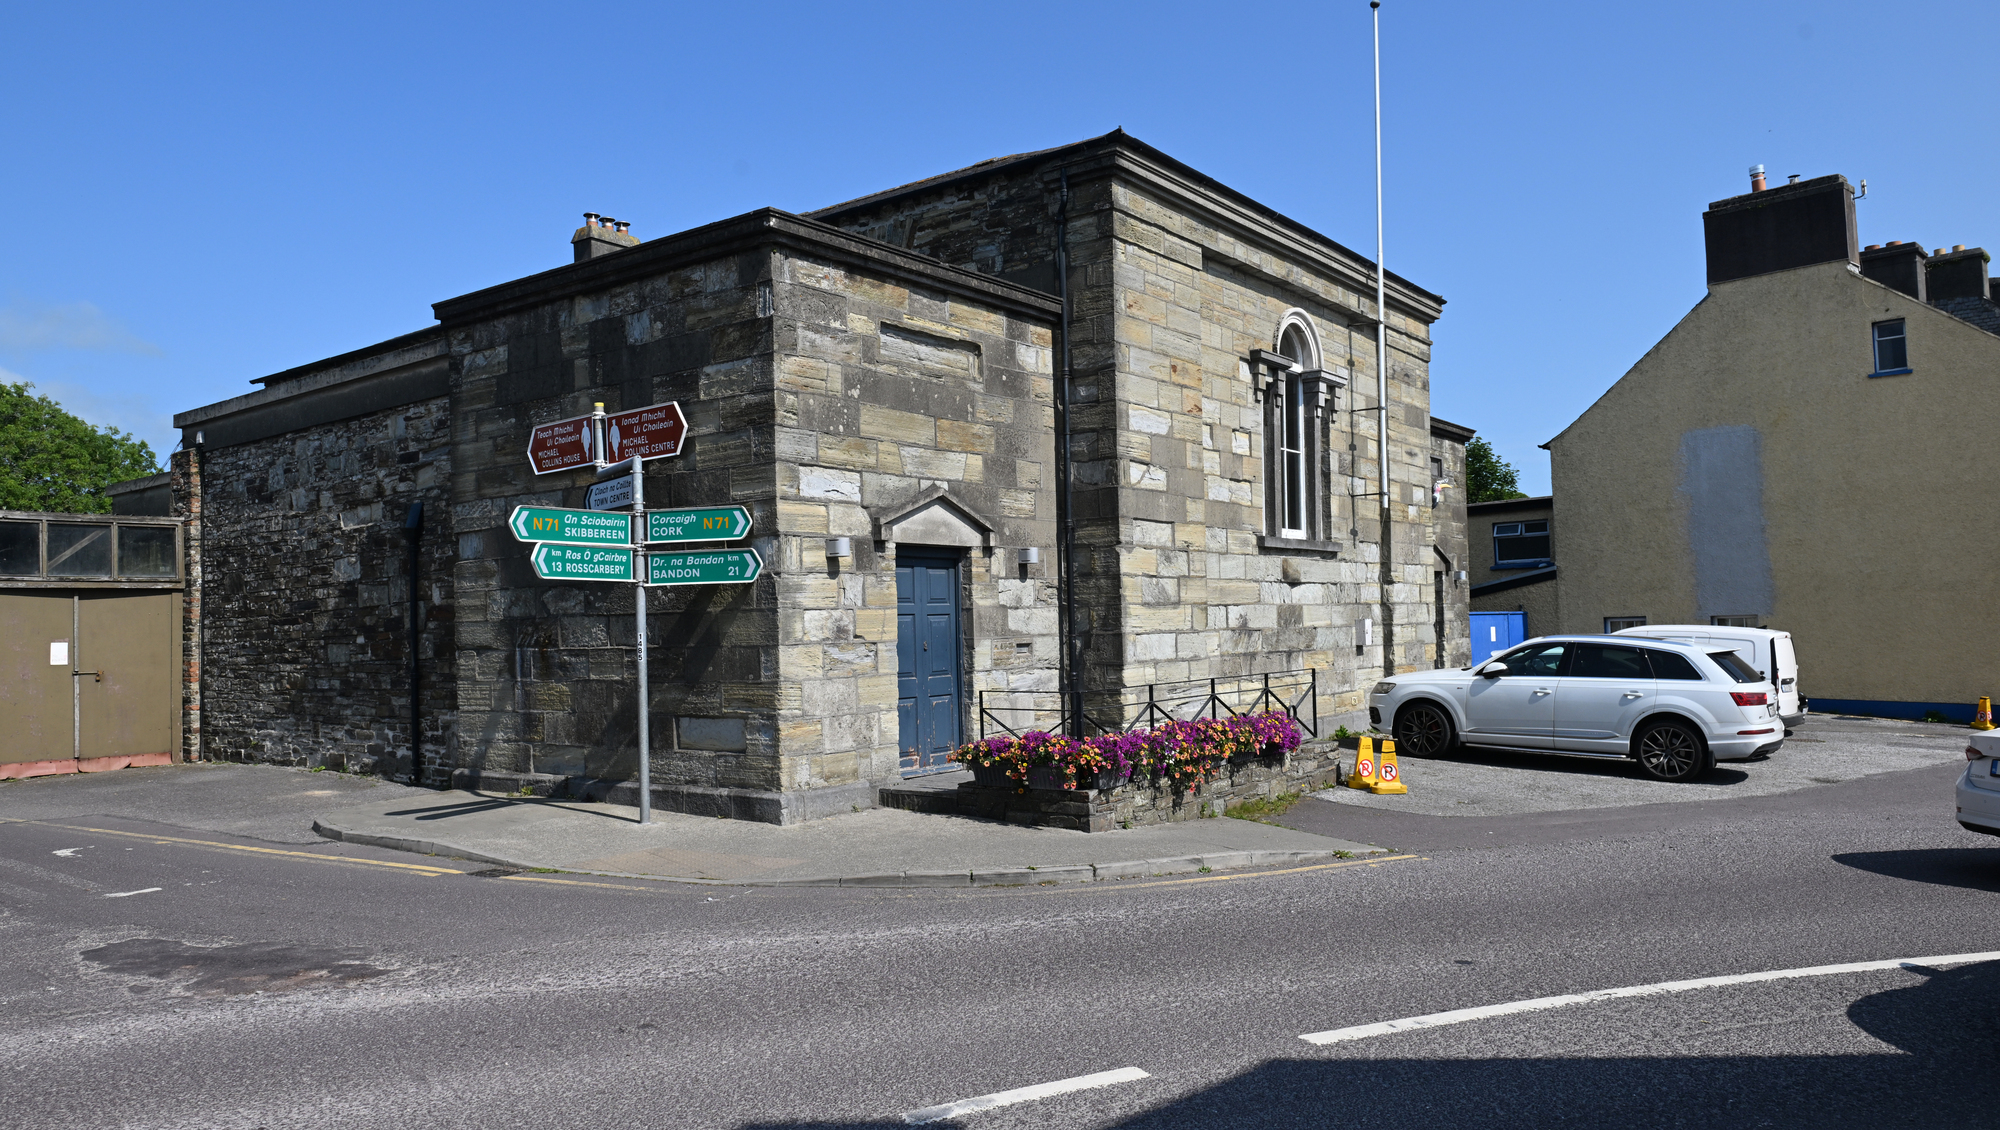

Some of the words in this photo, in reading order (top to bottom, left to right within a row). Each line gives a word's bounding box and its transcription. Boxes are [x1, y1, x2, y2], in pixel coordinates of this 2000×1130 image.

[621, 414, 640, 426] Ionad
[537, 429, 552, 439] Teach
[622, 435, 649, 447] MICHAEL
[538, 448, 559, 459] MICHAEL
[624, 445, 650, 457] COLLINS
[651, 440, 675, 453] CENTRE
[542, 456, 563, 468] COLLINS
[563, 453, 580, 464] HOUSE
[594, 496, 609, 507] TOWN
[609, 491, 630, 503] CENTRE
[651, 513, 697, 525] Corcaigh
[564, 527, 625, 540] SKIBBEREEN
[652, 526, 683, 537] CORK
[551, 548, 562, 557] km
[565, 550, 582, 560] Ros
[584, 548, 591, 560] Ó
[593, 552, 627, 563] gCairbre
[652, 557, 667, 567] Dr.
[671, 558, 683, 566] na
[686, 555, 725, 565] Bandan
[551, 561, 563, 572] 13
[566, 563, 625, 575] ROSSCARBERY
[653, 568, 700, 579] BANDON
[728, 566, 739, 576] 21
